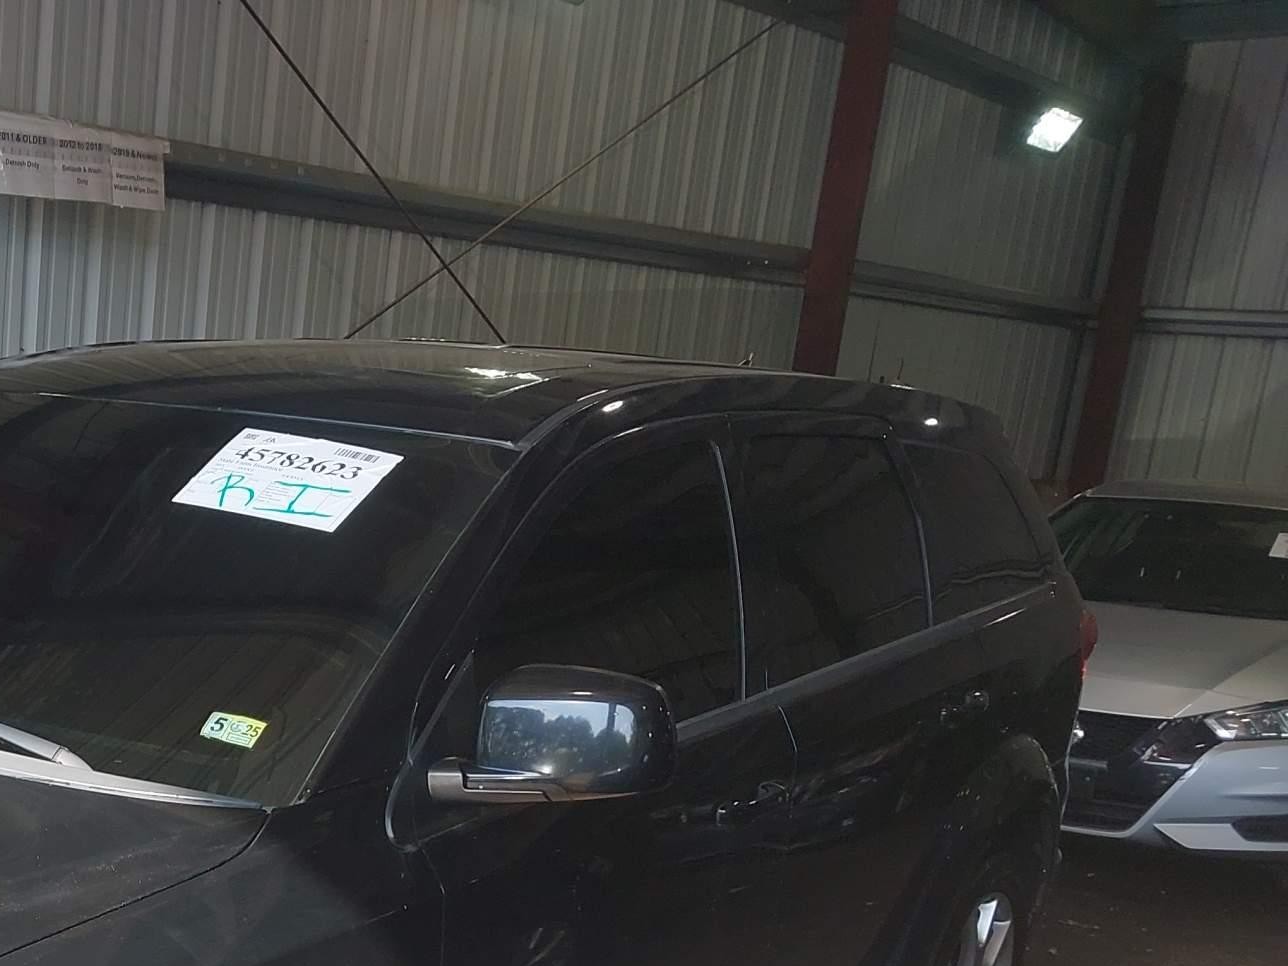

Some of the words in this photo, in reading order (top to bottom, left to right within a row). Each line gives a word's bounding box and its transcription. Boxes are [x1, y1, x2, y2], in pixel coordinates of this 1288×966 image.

[22, 134, 47, 145] OLDER
[235, 446, 363, 480] 45782623
[210, 717, 228, 732] 5
[241, 724, 262, 738] 25
